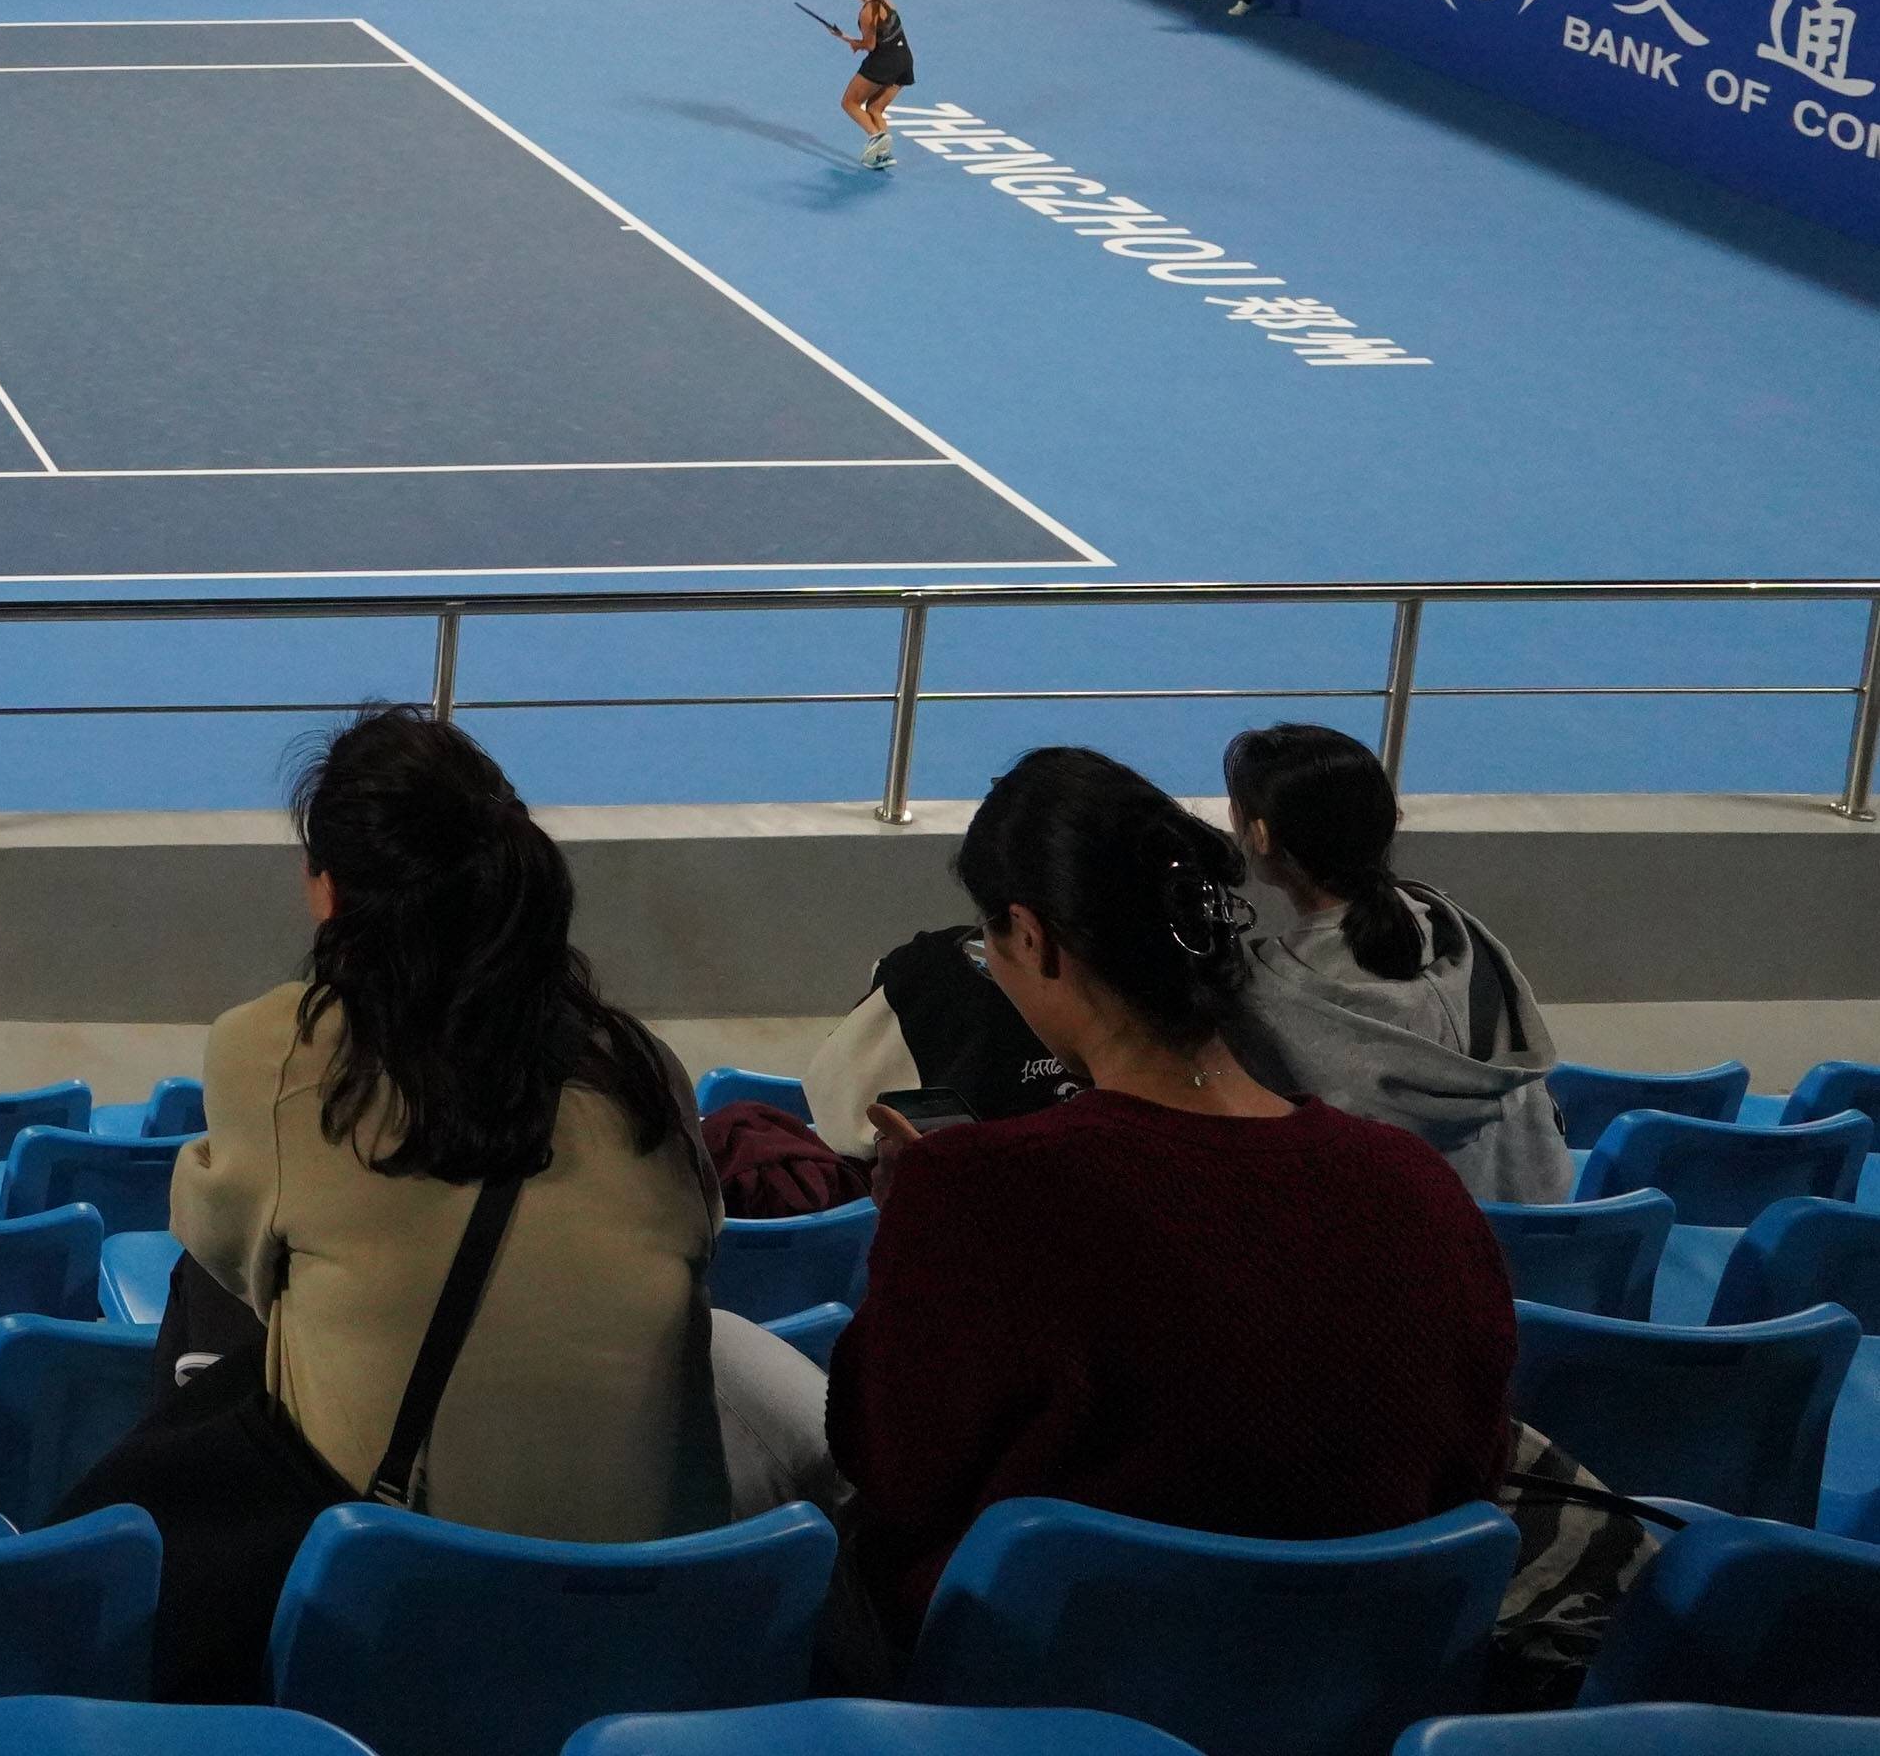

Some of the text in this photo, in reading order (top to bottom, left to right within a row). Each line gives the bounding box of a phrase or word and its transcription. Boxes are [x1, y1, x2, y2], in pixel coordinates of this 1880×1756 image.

[1563, 11, 1685, 87] BANK
[1705, 68, 1771, 113] OF
[861, 101, 1435, 367] ZHENGZHOU 郑州
